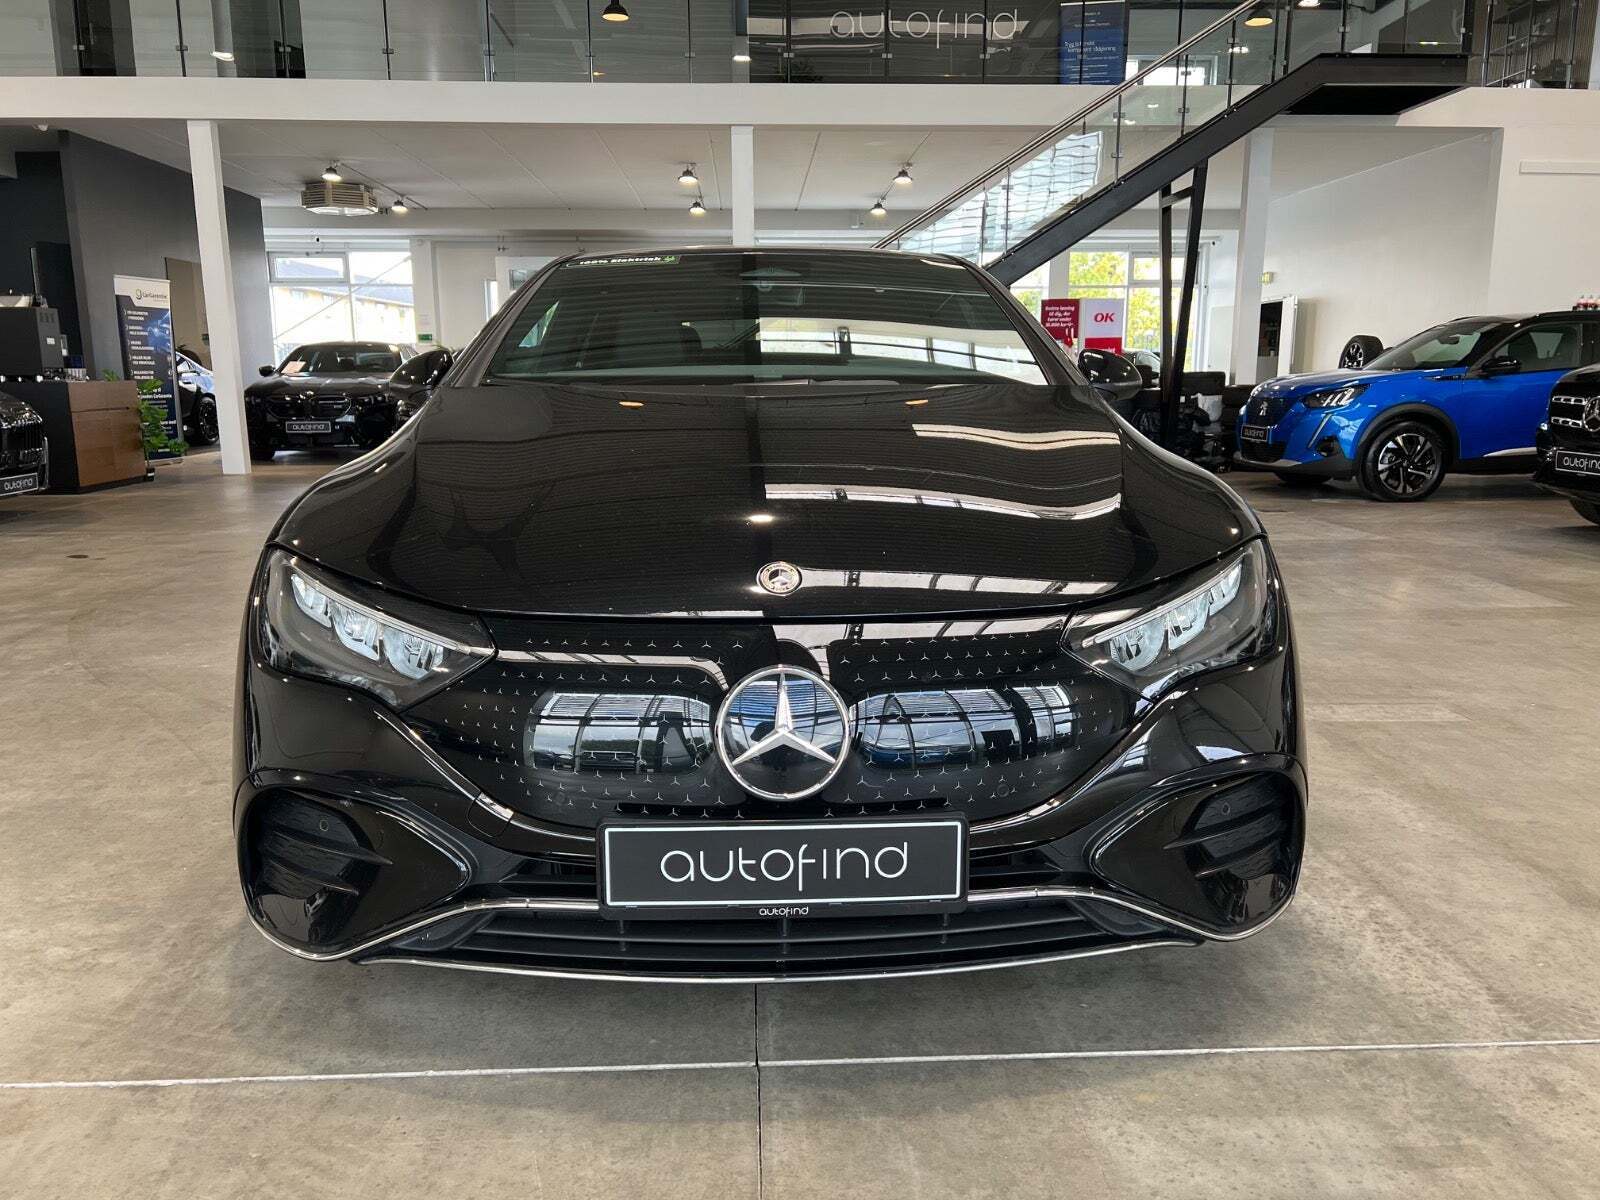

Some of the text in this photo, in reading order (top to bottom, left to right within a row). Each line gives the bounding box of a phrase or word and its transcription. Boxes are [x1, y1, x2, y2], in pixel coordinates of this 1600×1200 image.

[829, 9, 1018, 49] autofind
[1094, 312, 1115, 323] OK
[4, 478, 33, 491] autofind
[660, 842, 908, 891] autofind
[759, 905, 809, 918] autofind
